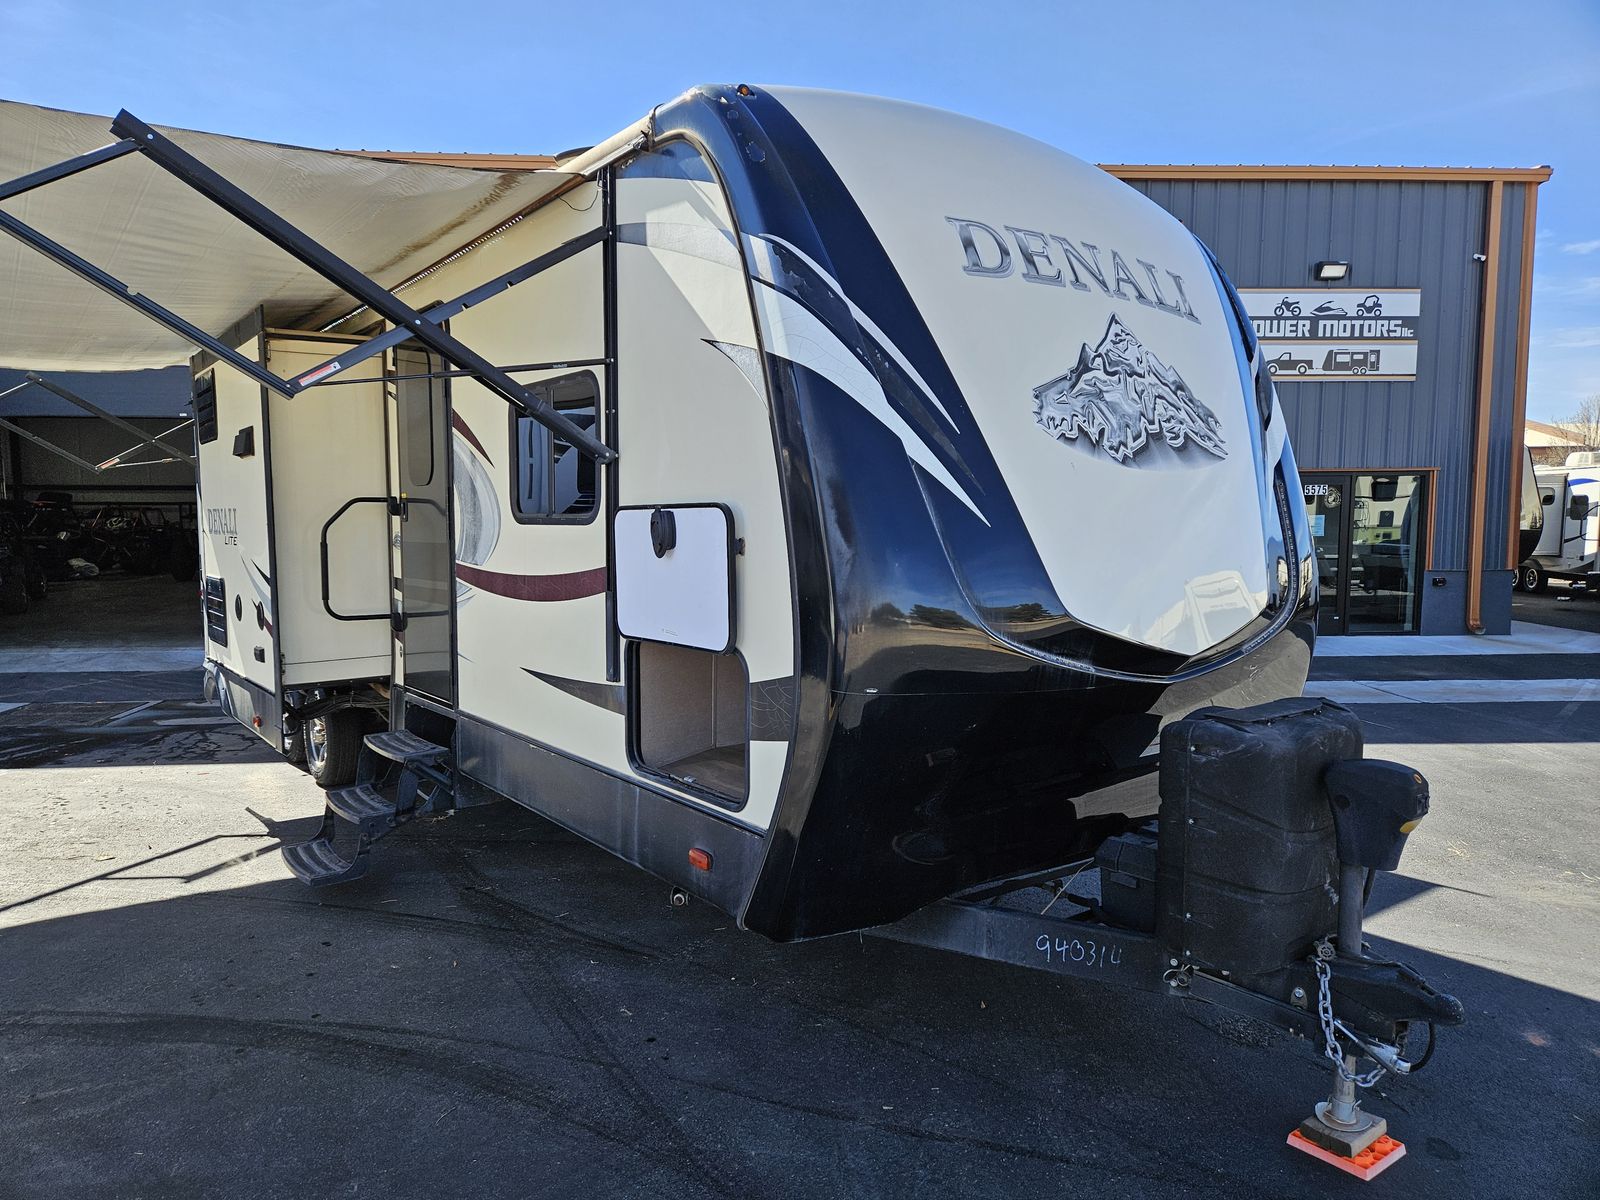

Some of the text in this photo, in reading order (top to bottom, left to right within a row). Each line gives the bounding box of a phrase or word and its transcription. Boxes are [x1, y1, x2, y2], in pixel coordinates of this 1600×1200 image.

[945, 216, 1202, 325] DENALI
[1251, 319, 1311, 338] OWER
[1317, 319, 1402, 338] MOTORS
[1305, 485, 1328, 496] 5575
[207, 508, 238, 535] DENALI
[224, 535, 238, 546] LITE
[1035, 934, 1123, 968] 940314
